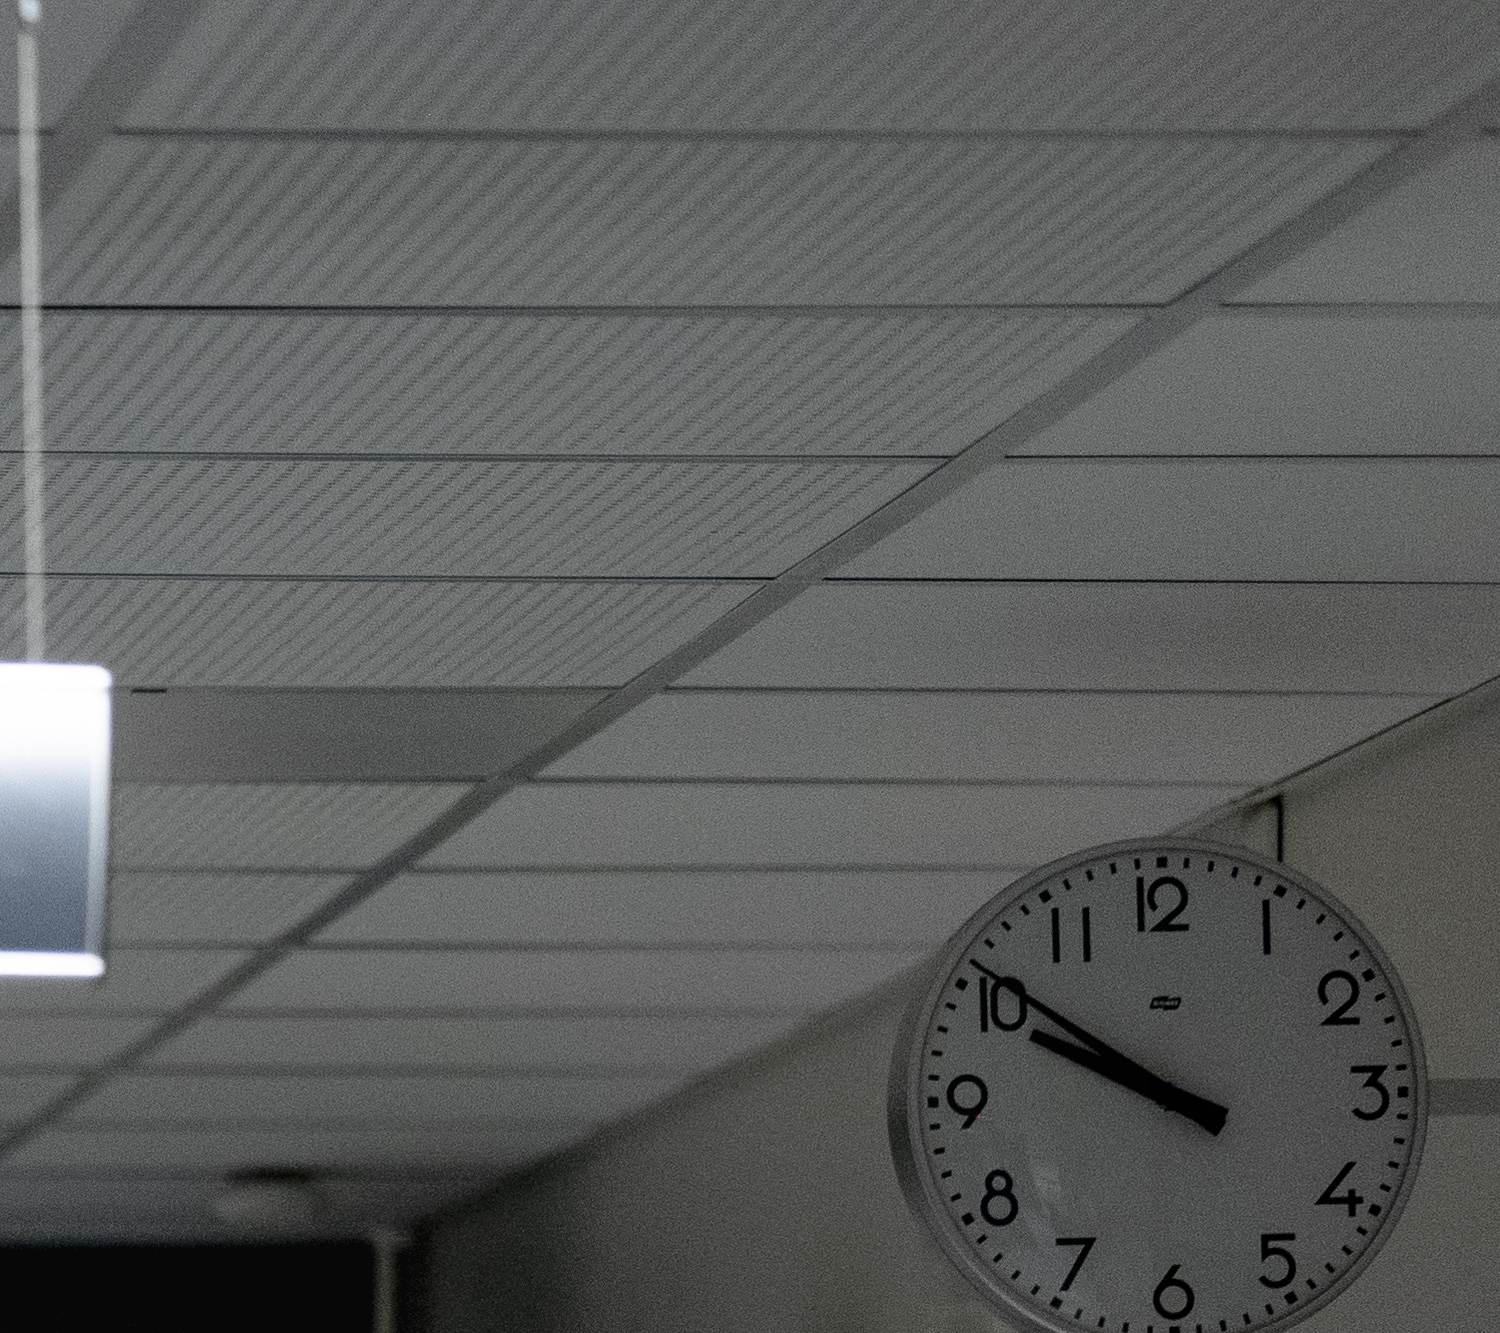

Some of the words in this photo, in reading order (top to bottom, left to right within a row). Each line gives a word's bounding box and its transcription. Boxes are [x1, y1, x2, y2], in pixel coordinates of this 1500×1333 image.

[1133, 874, 1190, 934] 12
[1260, 898, 1273, 957] 1
[1049, 906, 1093, 964] 11
[978, 975, 1028, 1032] 10
[1316, 968, 1362, 1027] 2
[944, 1073, 990, 1130] 9
[1350, 1063, 1391, 1122] 3
[979, 1168, 1020, 1228] 8
[1315, 1160, 1366, 1218] 4
[1055, 1235, 1098, 1293] 7
[1259, 1232, 1298, 1290] 5
[1152, 1263, 1196, 1322] 6
